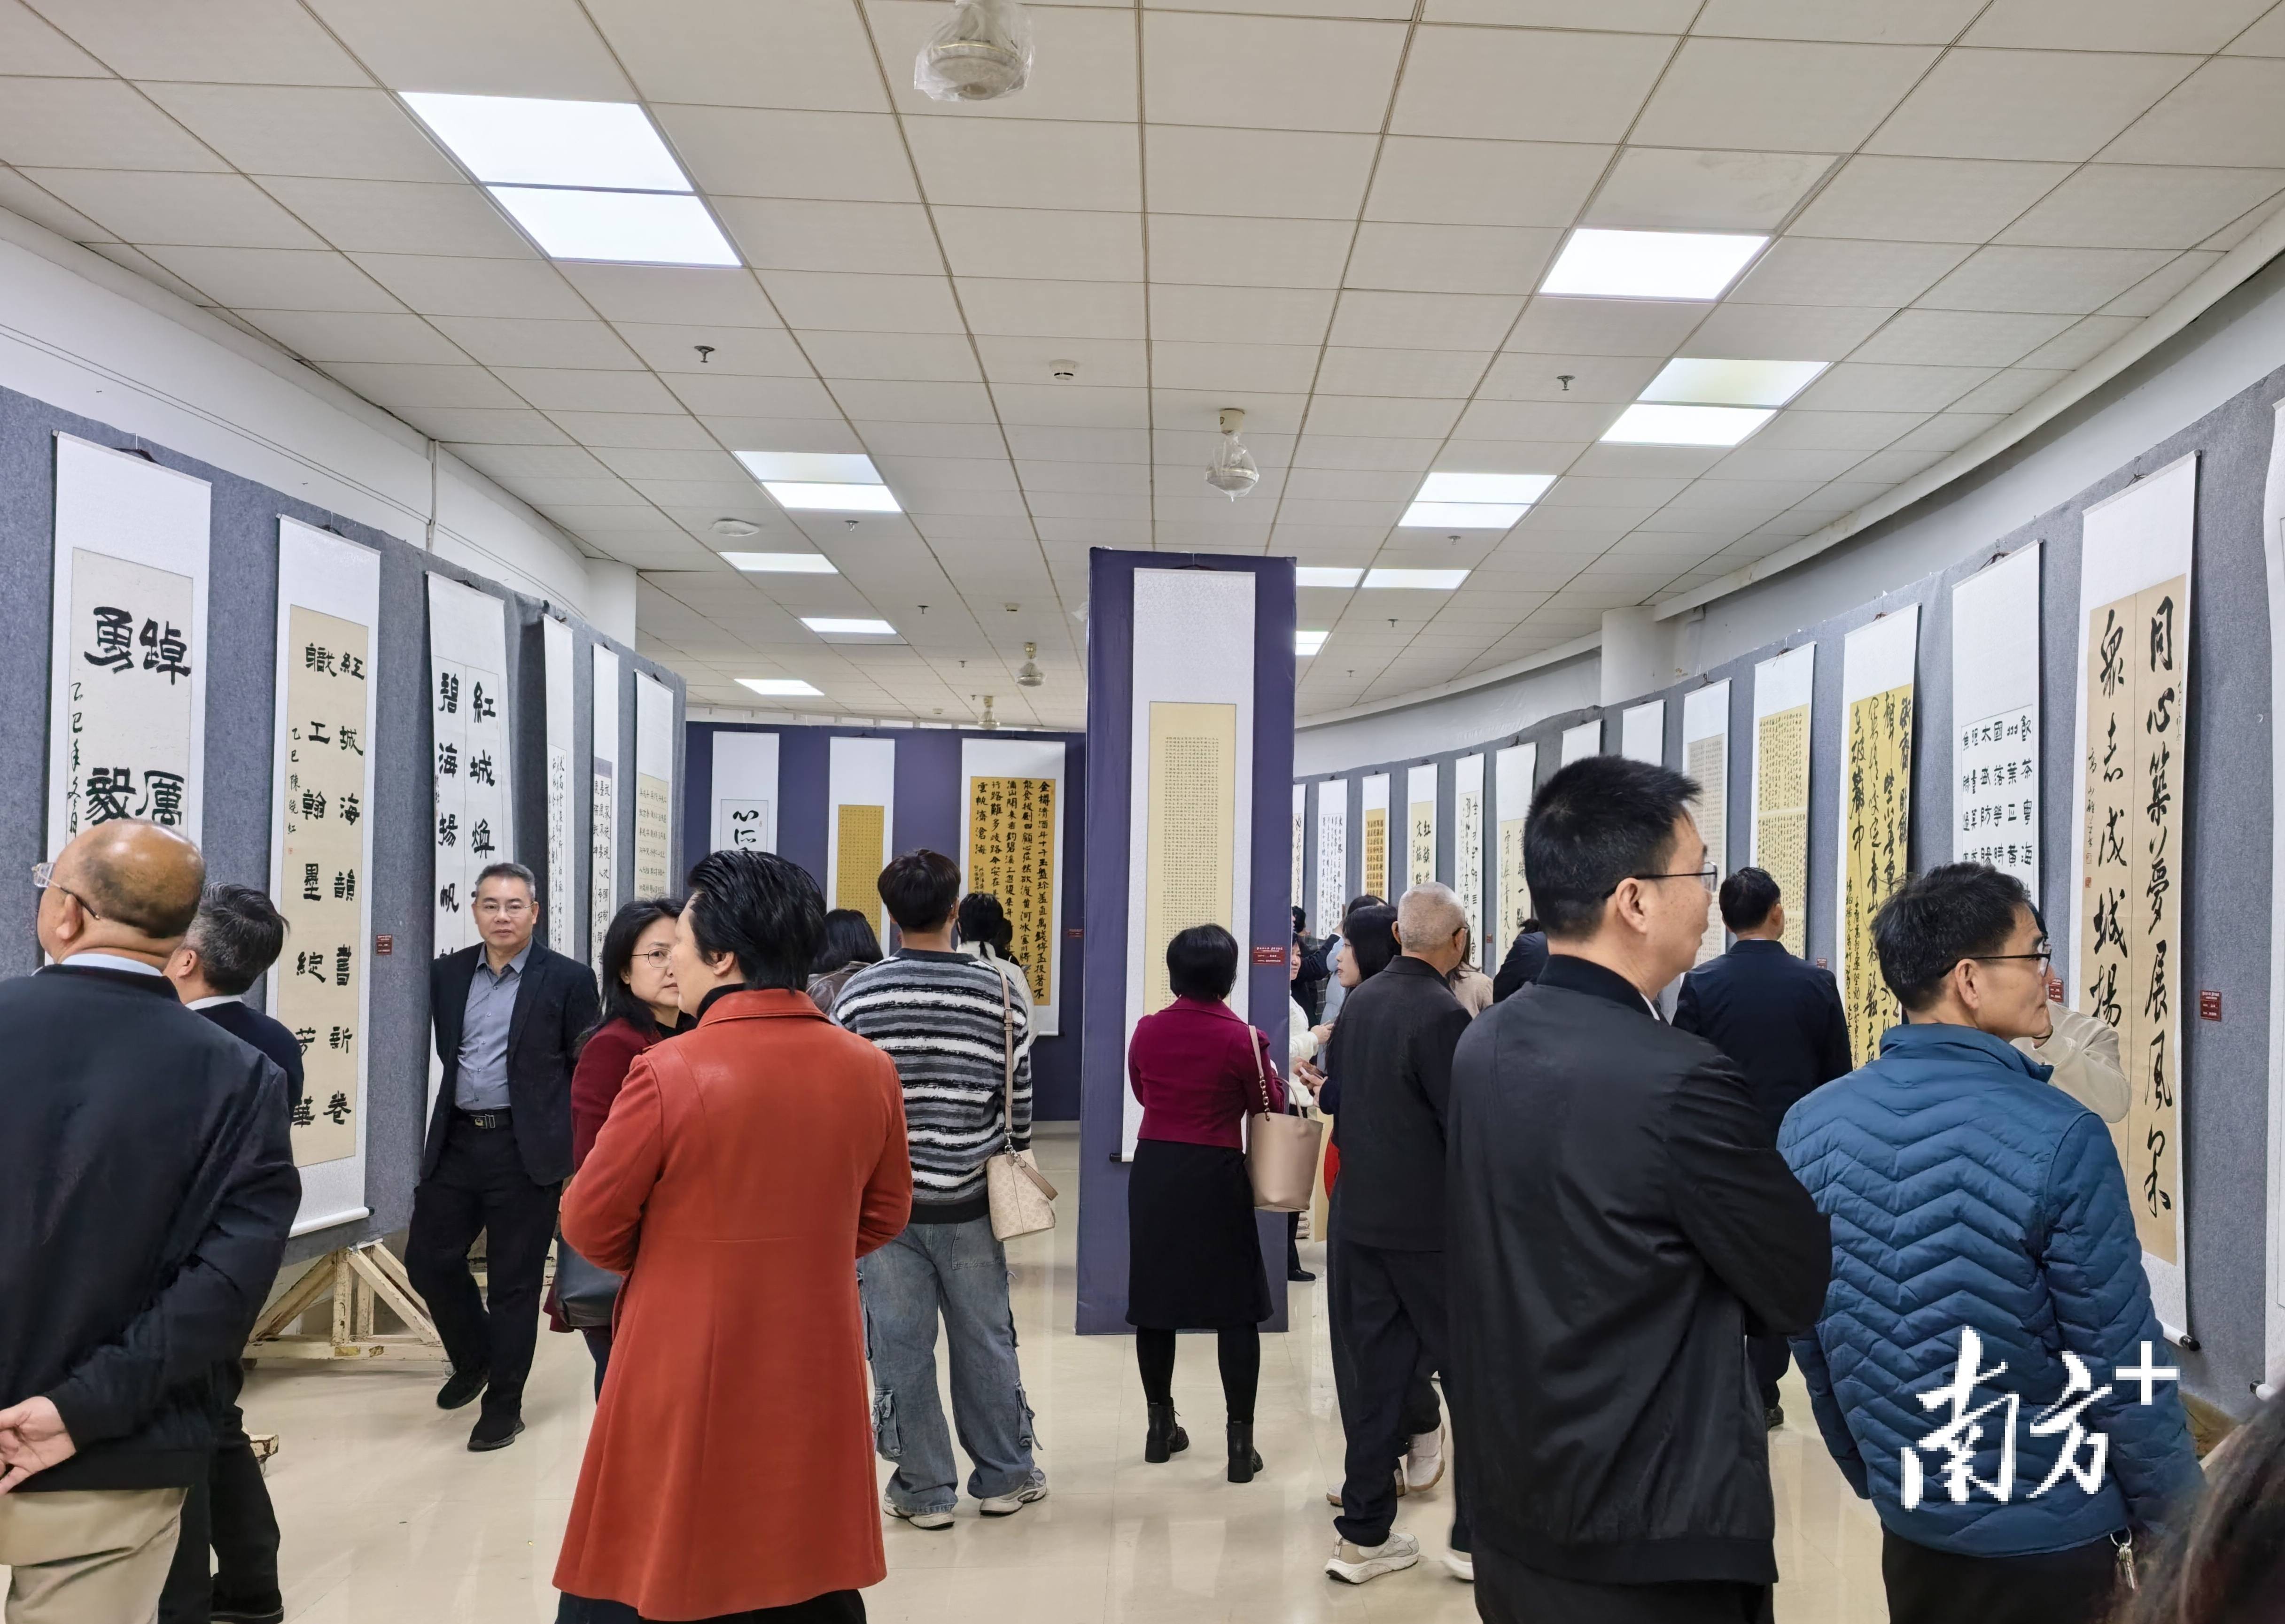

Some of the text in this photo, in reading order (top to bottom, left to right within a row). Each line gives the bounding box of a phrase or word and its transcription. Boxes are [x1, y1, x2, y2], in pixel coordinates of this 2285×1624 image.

[84, 606, 137, 825] 勇毅
[470, 681, 496, 897] 紅城煥
